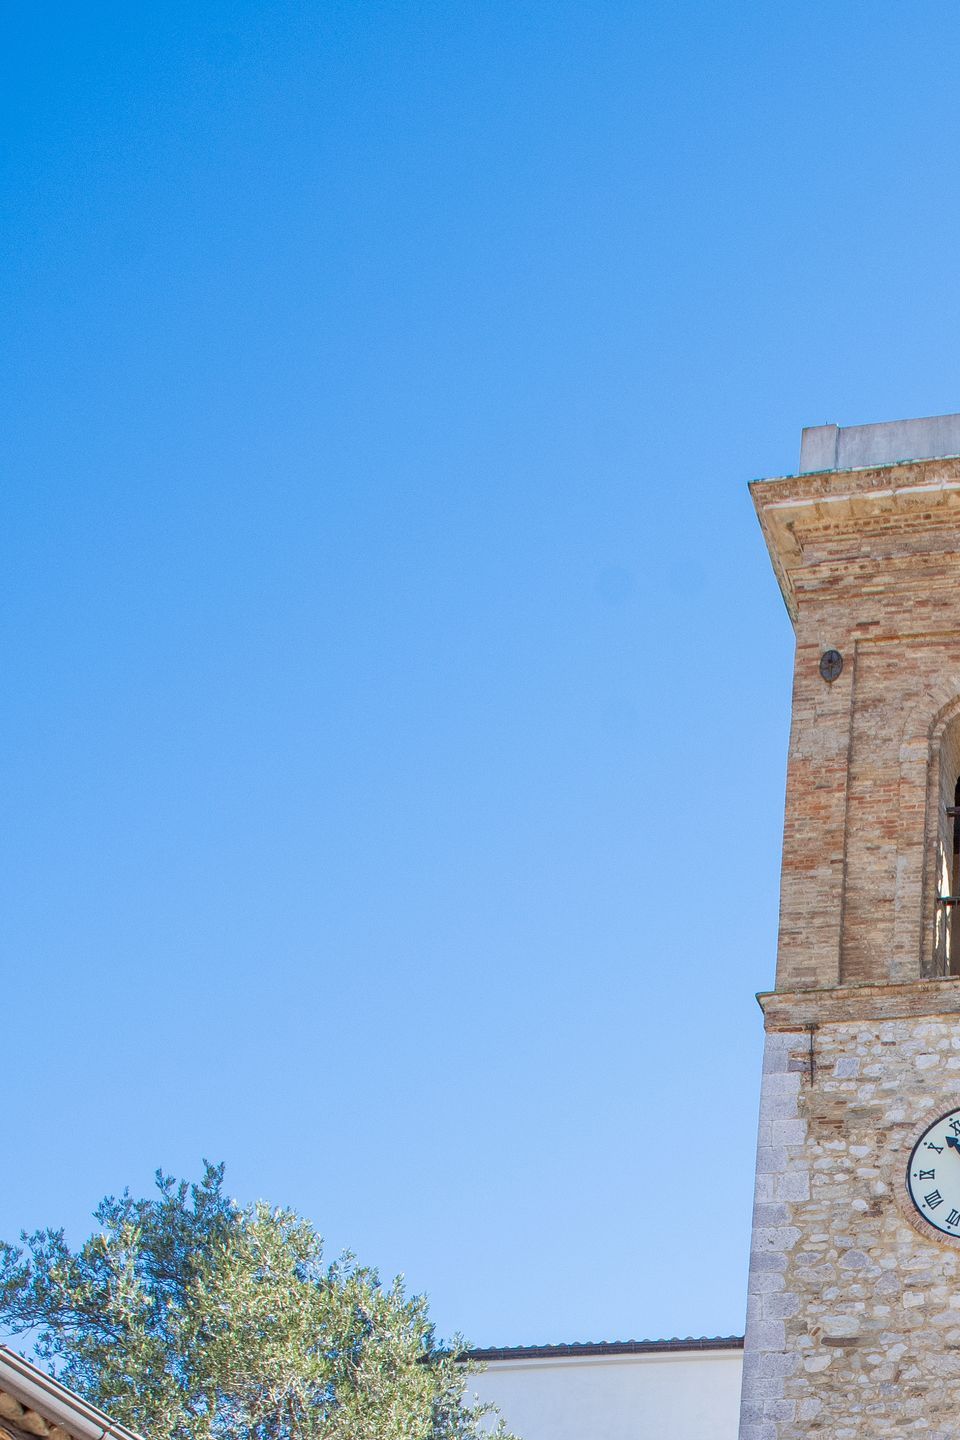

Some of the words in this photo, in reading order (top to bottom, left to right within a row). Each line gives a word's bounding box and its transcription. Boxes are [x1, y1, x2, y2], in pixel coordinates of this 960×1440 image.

[927, 1142, 944, 1154] X
[919, 1168, 936, 1180] IX
[924, 1189, 944, 1210] VIII
